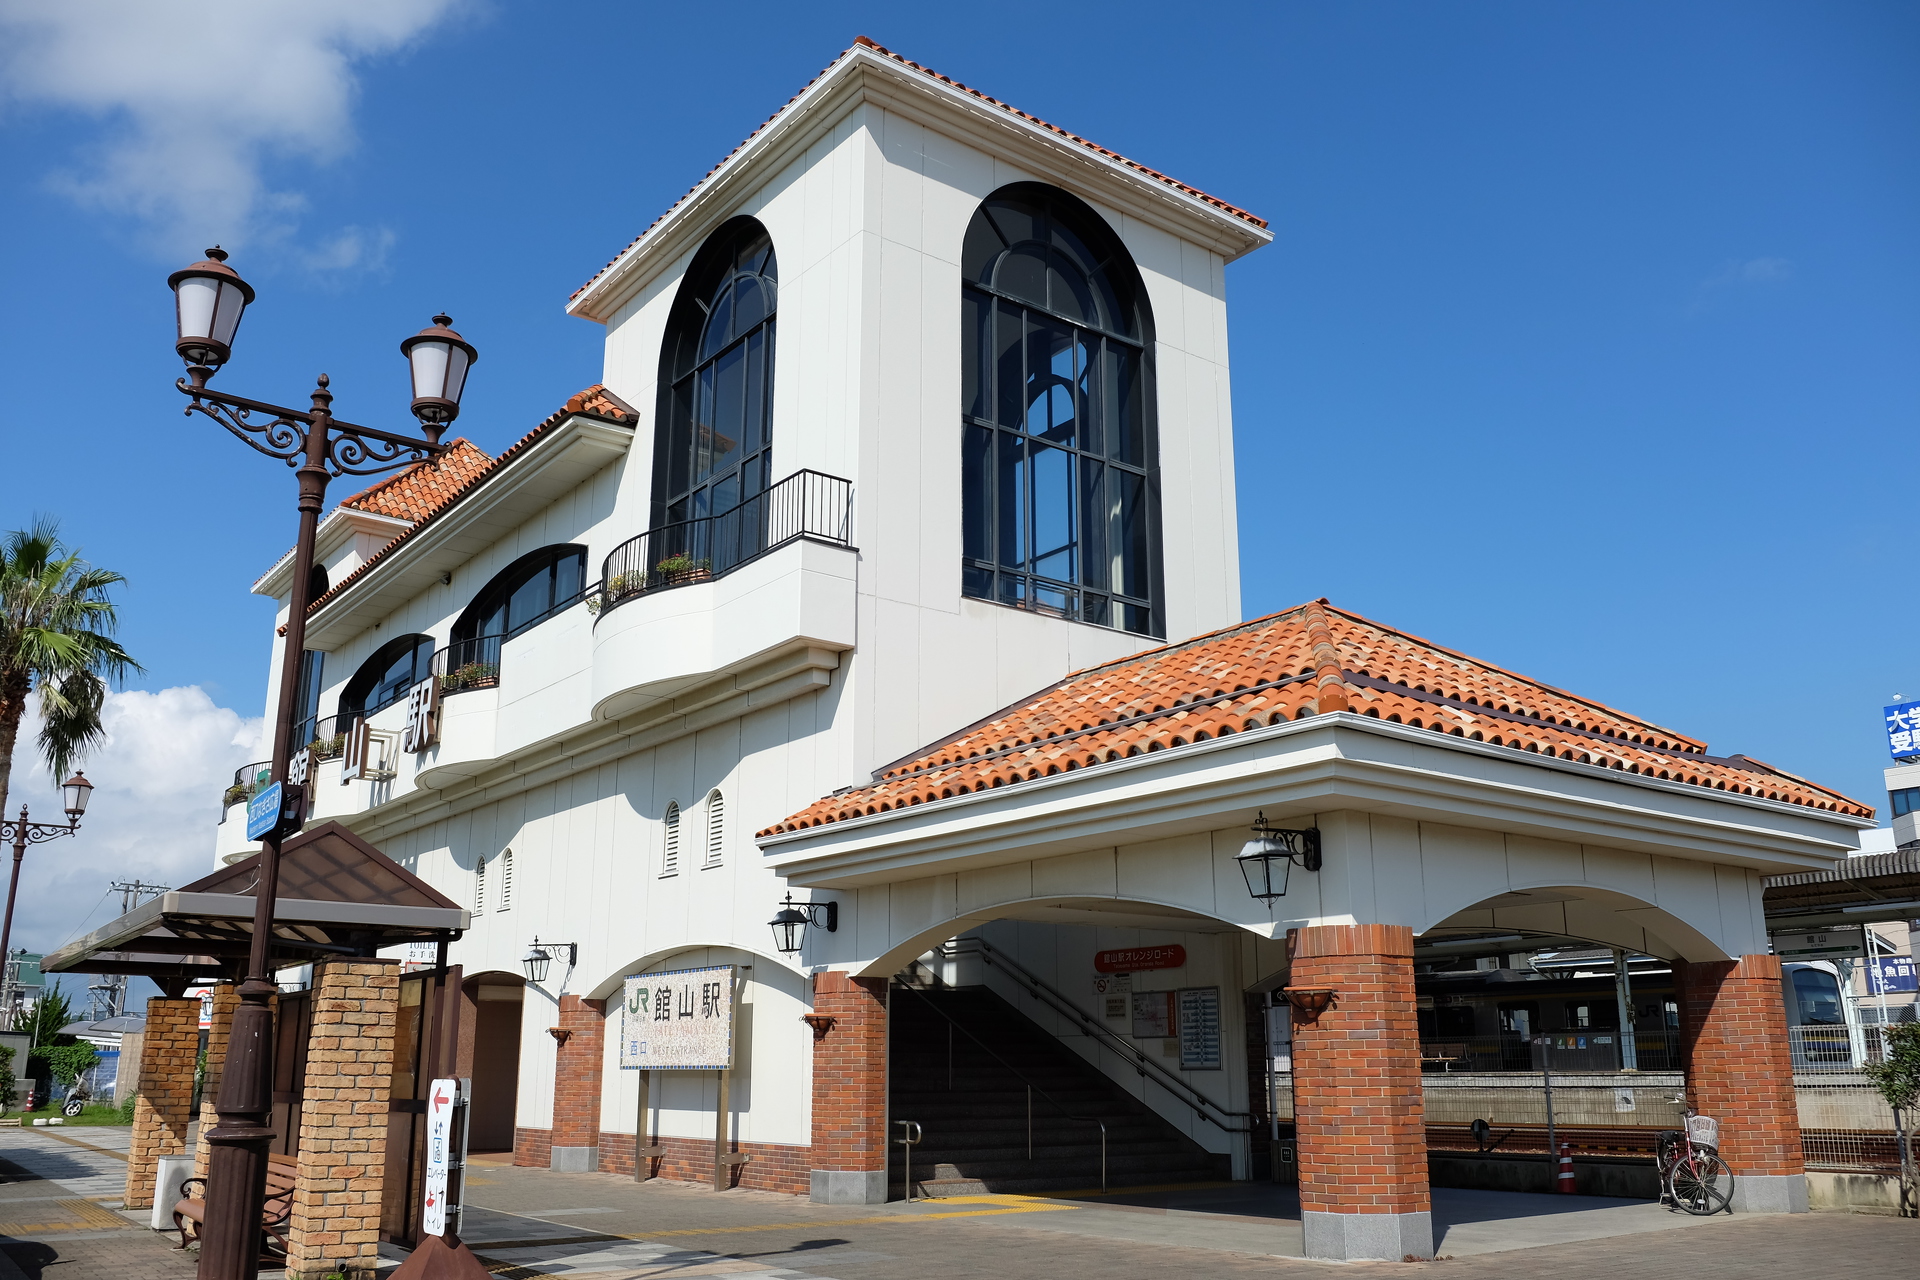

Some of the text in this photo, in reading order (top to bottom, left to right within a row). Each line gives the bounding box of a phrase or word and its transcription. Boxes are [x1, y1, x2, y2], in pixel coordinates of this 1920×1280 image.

[1806, 934, 1827, 944] 館山
[1103, 948, 1175, 964] 館山駅オレンジロード
[629, 987, 649, 1014] JR
[654, 982, 721, 1022] 館山駅
[1639, 1005, 1660, 1017] JR
[630, 1040, 647, 1056] 西口
[427, 1166, 447, 1181] エレベーター
[426, 1217, 442, 1230] トイレ
